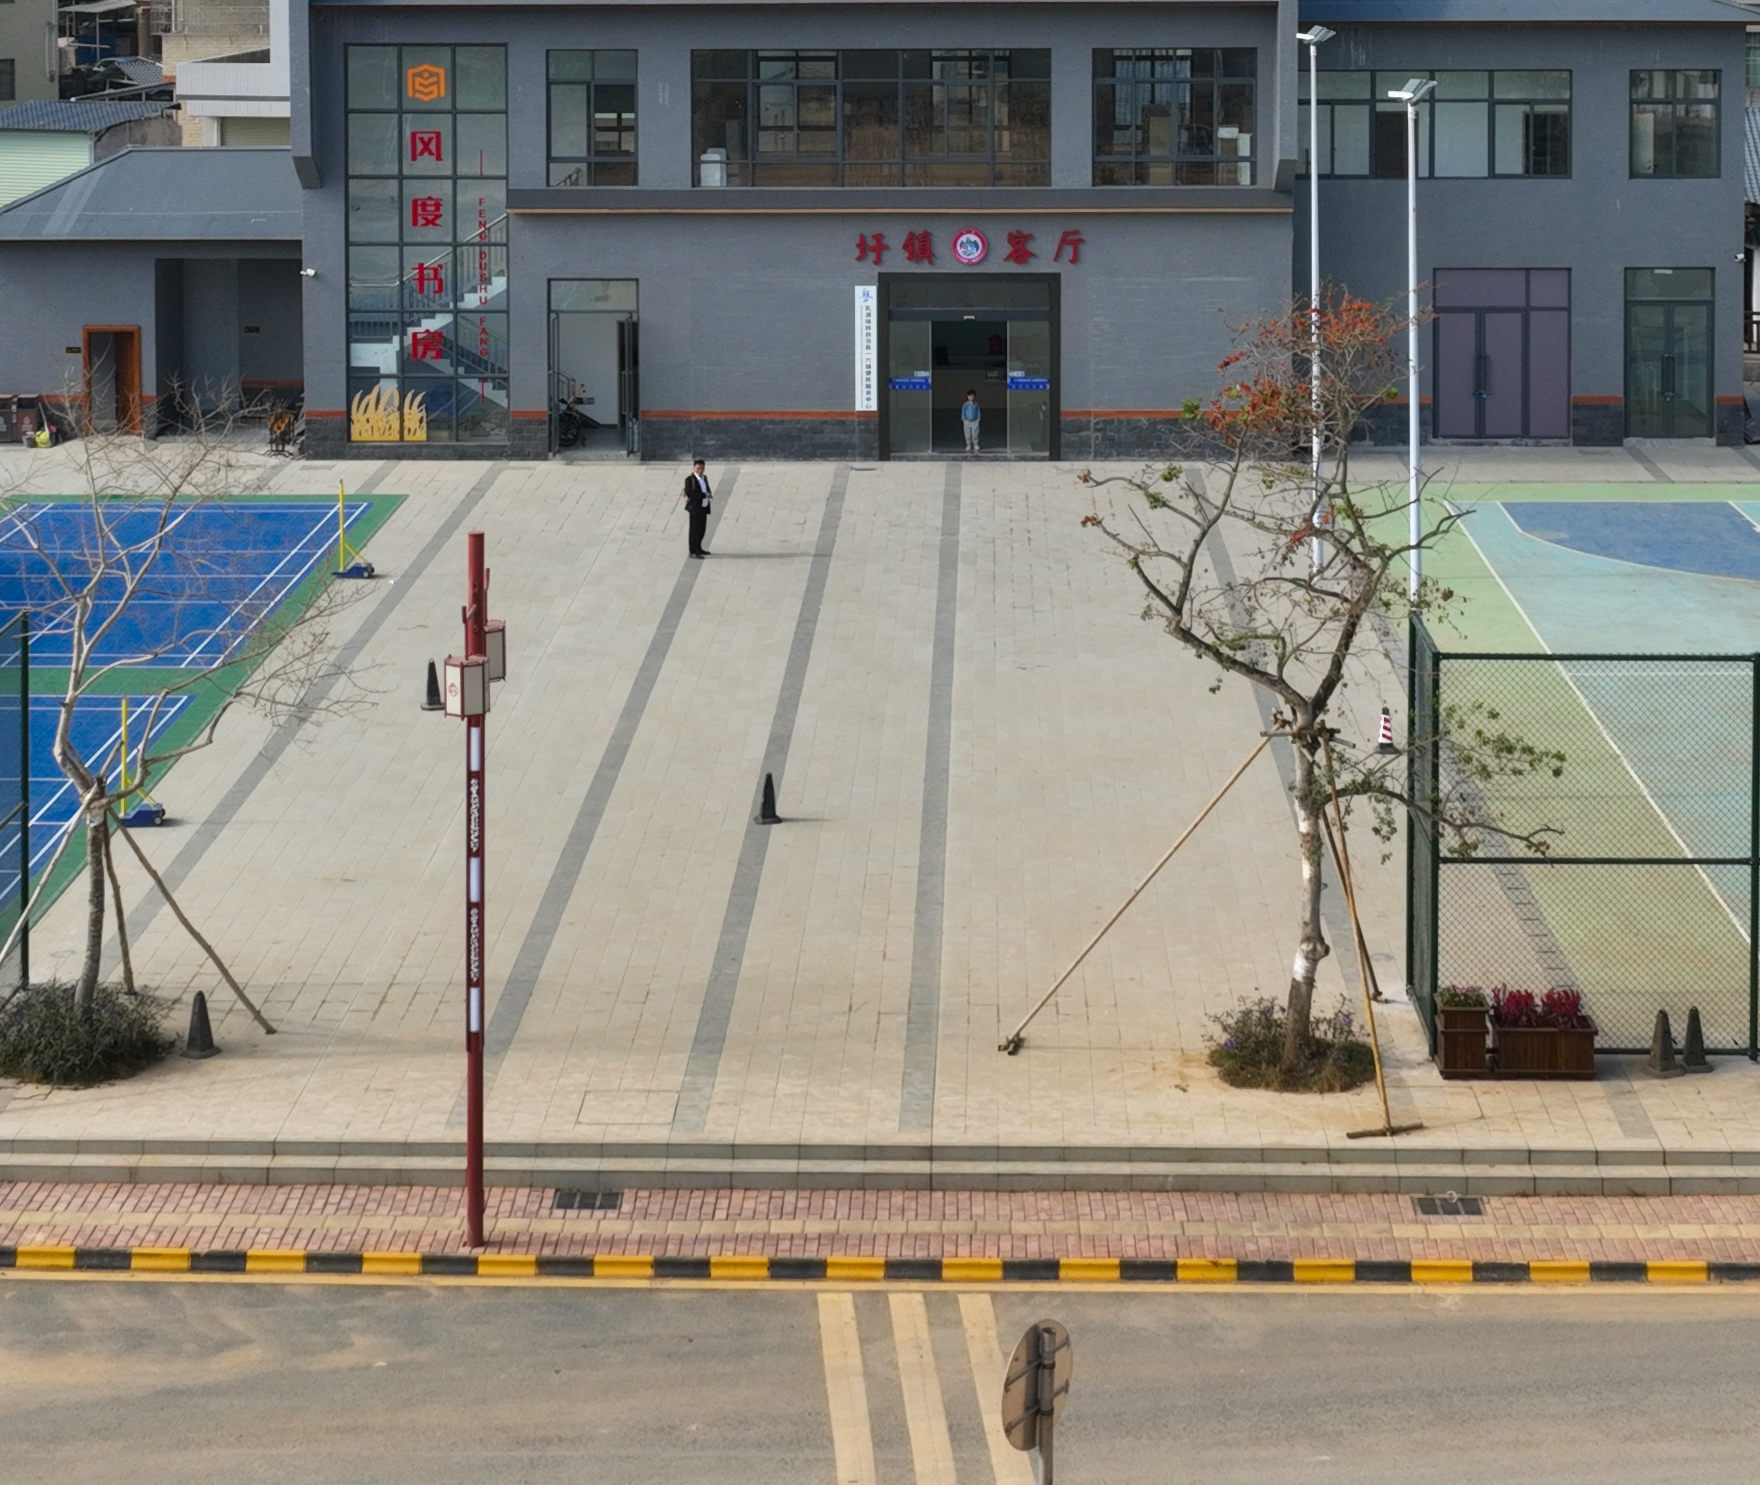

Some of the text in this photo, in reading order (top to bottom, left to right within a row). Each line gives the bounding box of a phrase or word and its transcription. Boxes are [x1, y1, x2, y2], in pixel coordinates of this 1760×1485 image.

[410, 130, 445, 362] 风度书房
[478, 197, 489, 358] FENG DUSHU FANG
[855, 231, 936, 265] 圩镇
[1003, 229, 1085, 265] 客厅
